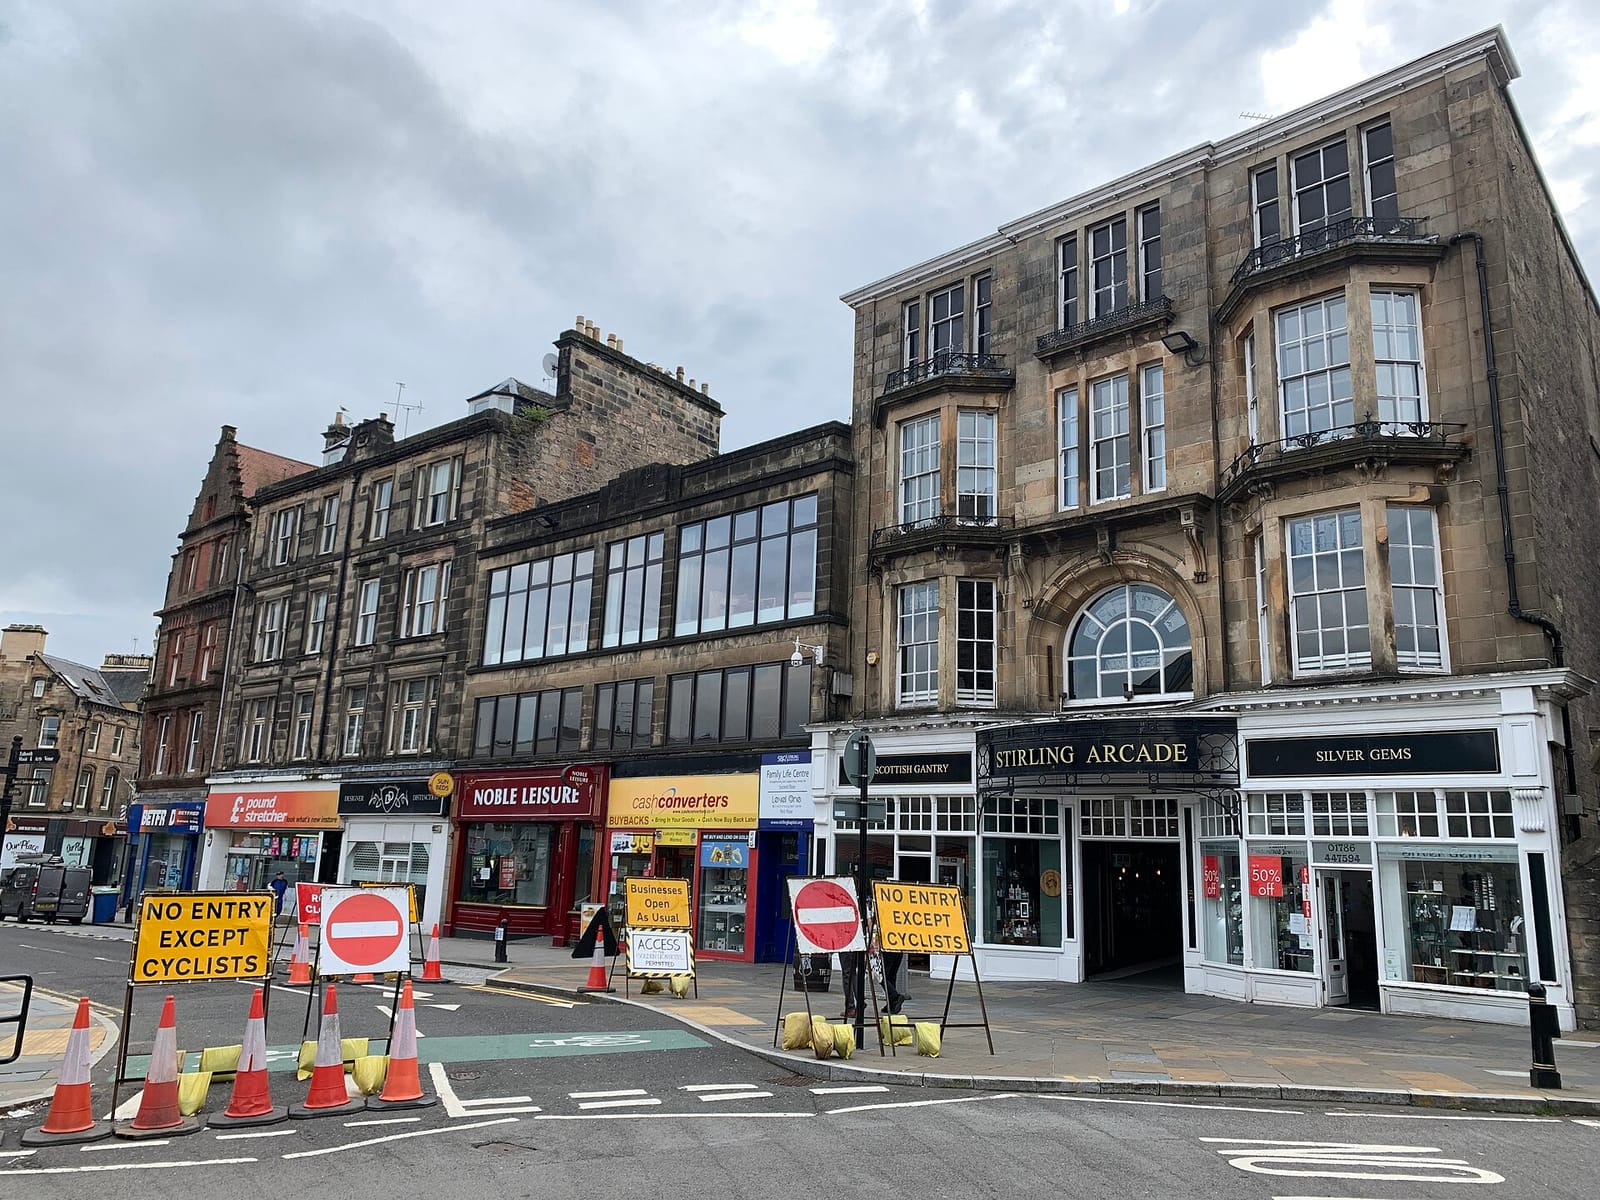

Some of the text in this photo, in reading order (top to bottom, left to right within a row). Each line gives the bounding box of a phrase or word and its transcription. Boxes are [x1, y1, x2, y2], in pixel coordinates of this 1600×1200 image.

[996, 743, 1189, 769] STIRLING ARCADE
[1316, 747, 1412, 762] SILVER GEMS
[571, 770, 588, 778] NOBLE
[766, 769, 809, 780] Family Life Centre
[874, 763, 949, 775] SCOTTISH GANTRY
[569, 776, 589, 784] LEISURE
[473, 785, 580, 806] NOBLE LEISURE
[246, 795, 277, 810] pound
[244, 810, 288, 823] stretcher
[609, 816, 650, 826] BUYBACKS
[723, 816, 733, 825] Buy
[5, 840, 39, 852] Our Place
[1327, 843, 1356, 852] 01786
[1324, 854, 1361, 863] 447594
[1204, 870, 1219, 882] 50%
[1252, 869, 1281, 882] 50%
[630, 884, 682, 895] Businesses
[1207, 882, 1217, 895] off
[1258, 882, 1275, 896] off
[644, 898, 670, 909] Open
[880, 887, 957, 907] NO ENTRY
[146, 901, 267, 921] NO ENTRY
[637, 912, 680, 923] As Usual
[893, 910, 951, 928] EXCEPT
[159, 927, 250, 948] EXCEPT
[887, 932, 963, 950] CYCLISTS
[637, 938, 681, 951] ACCESS
[142, 955, 259, 977] CYCLISTS
